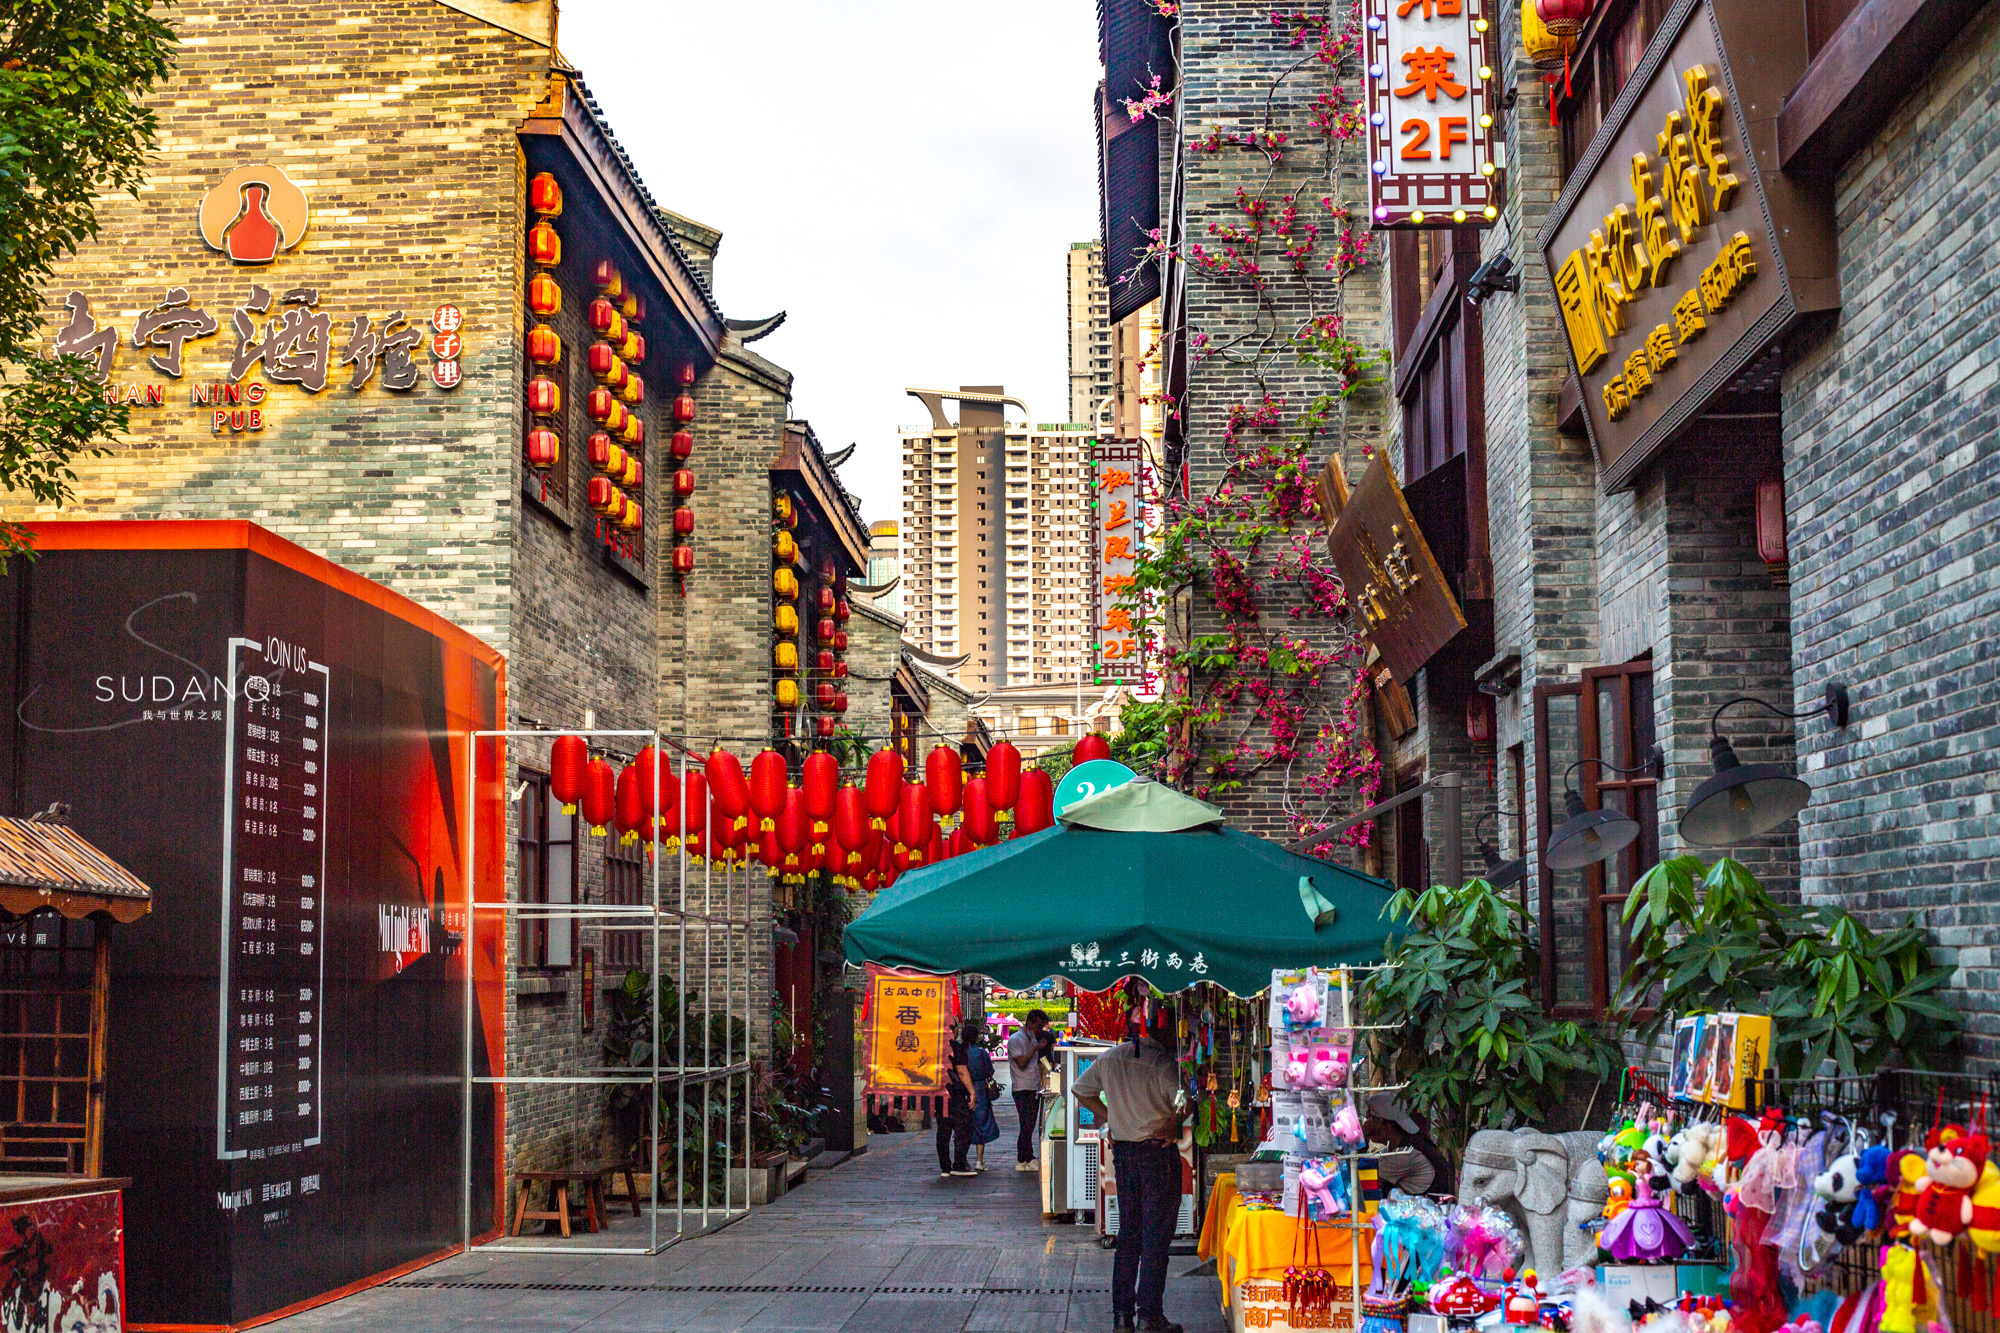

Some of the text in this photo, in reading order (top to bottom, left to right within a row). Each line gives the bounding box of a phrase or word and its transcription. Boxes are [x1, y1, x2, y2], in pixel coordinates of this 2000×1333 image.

[1401, 117, 1467, 159] 2F
[53, 285, 423, 393] 南宁酒馆
[434, 305, 461, 387] 巷子里
[103, 382, 266, 404] NAN NING
[214, 410, 262, 431] PUB
[264, 635, 306, 674] JOIN US
[1104, 640, 1136, 660] 2F
[142, 710, 222, 721] 我与世界之观
[1117, 948, 1209, 974] 三街两巷
[883, 986, 937, 998] 古风中药
